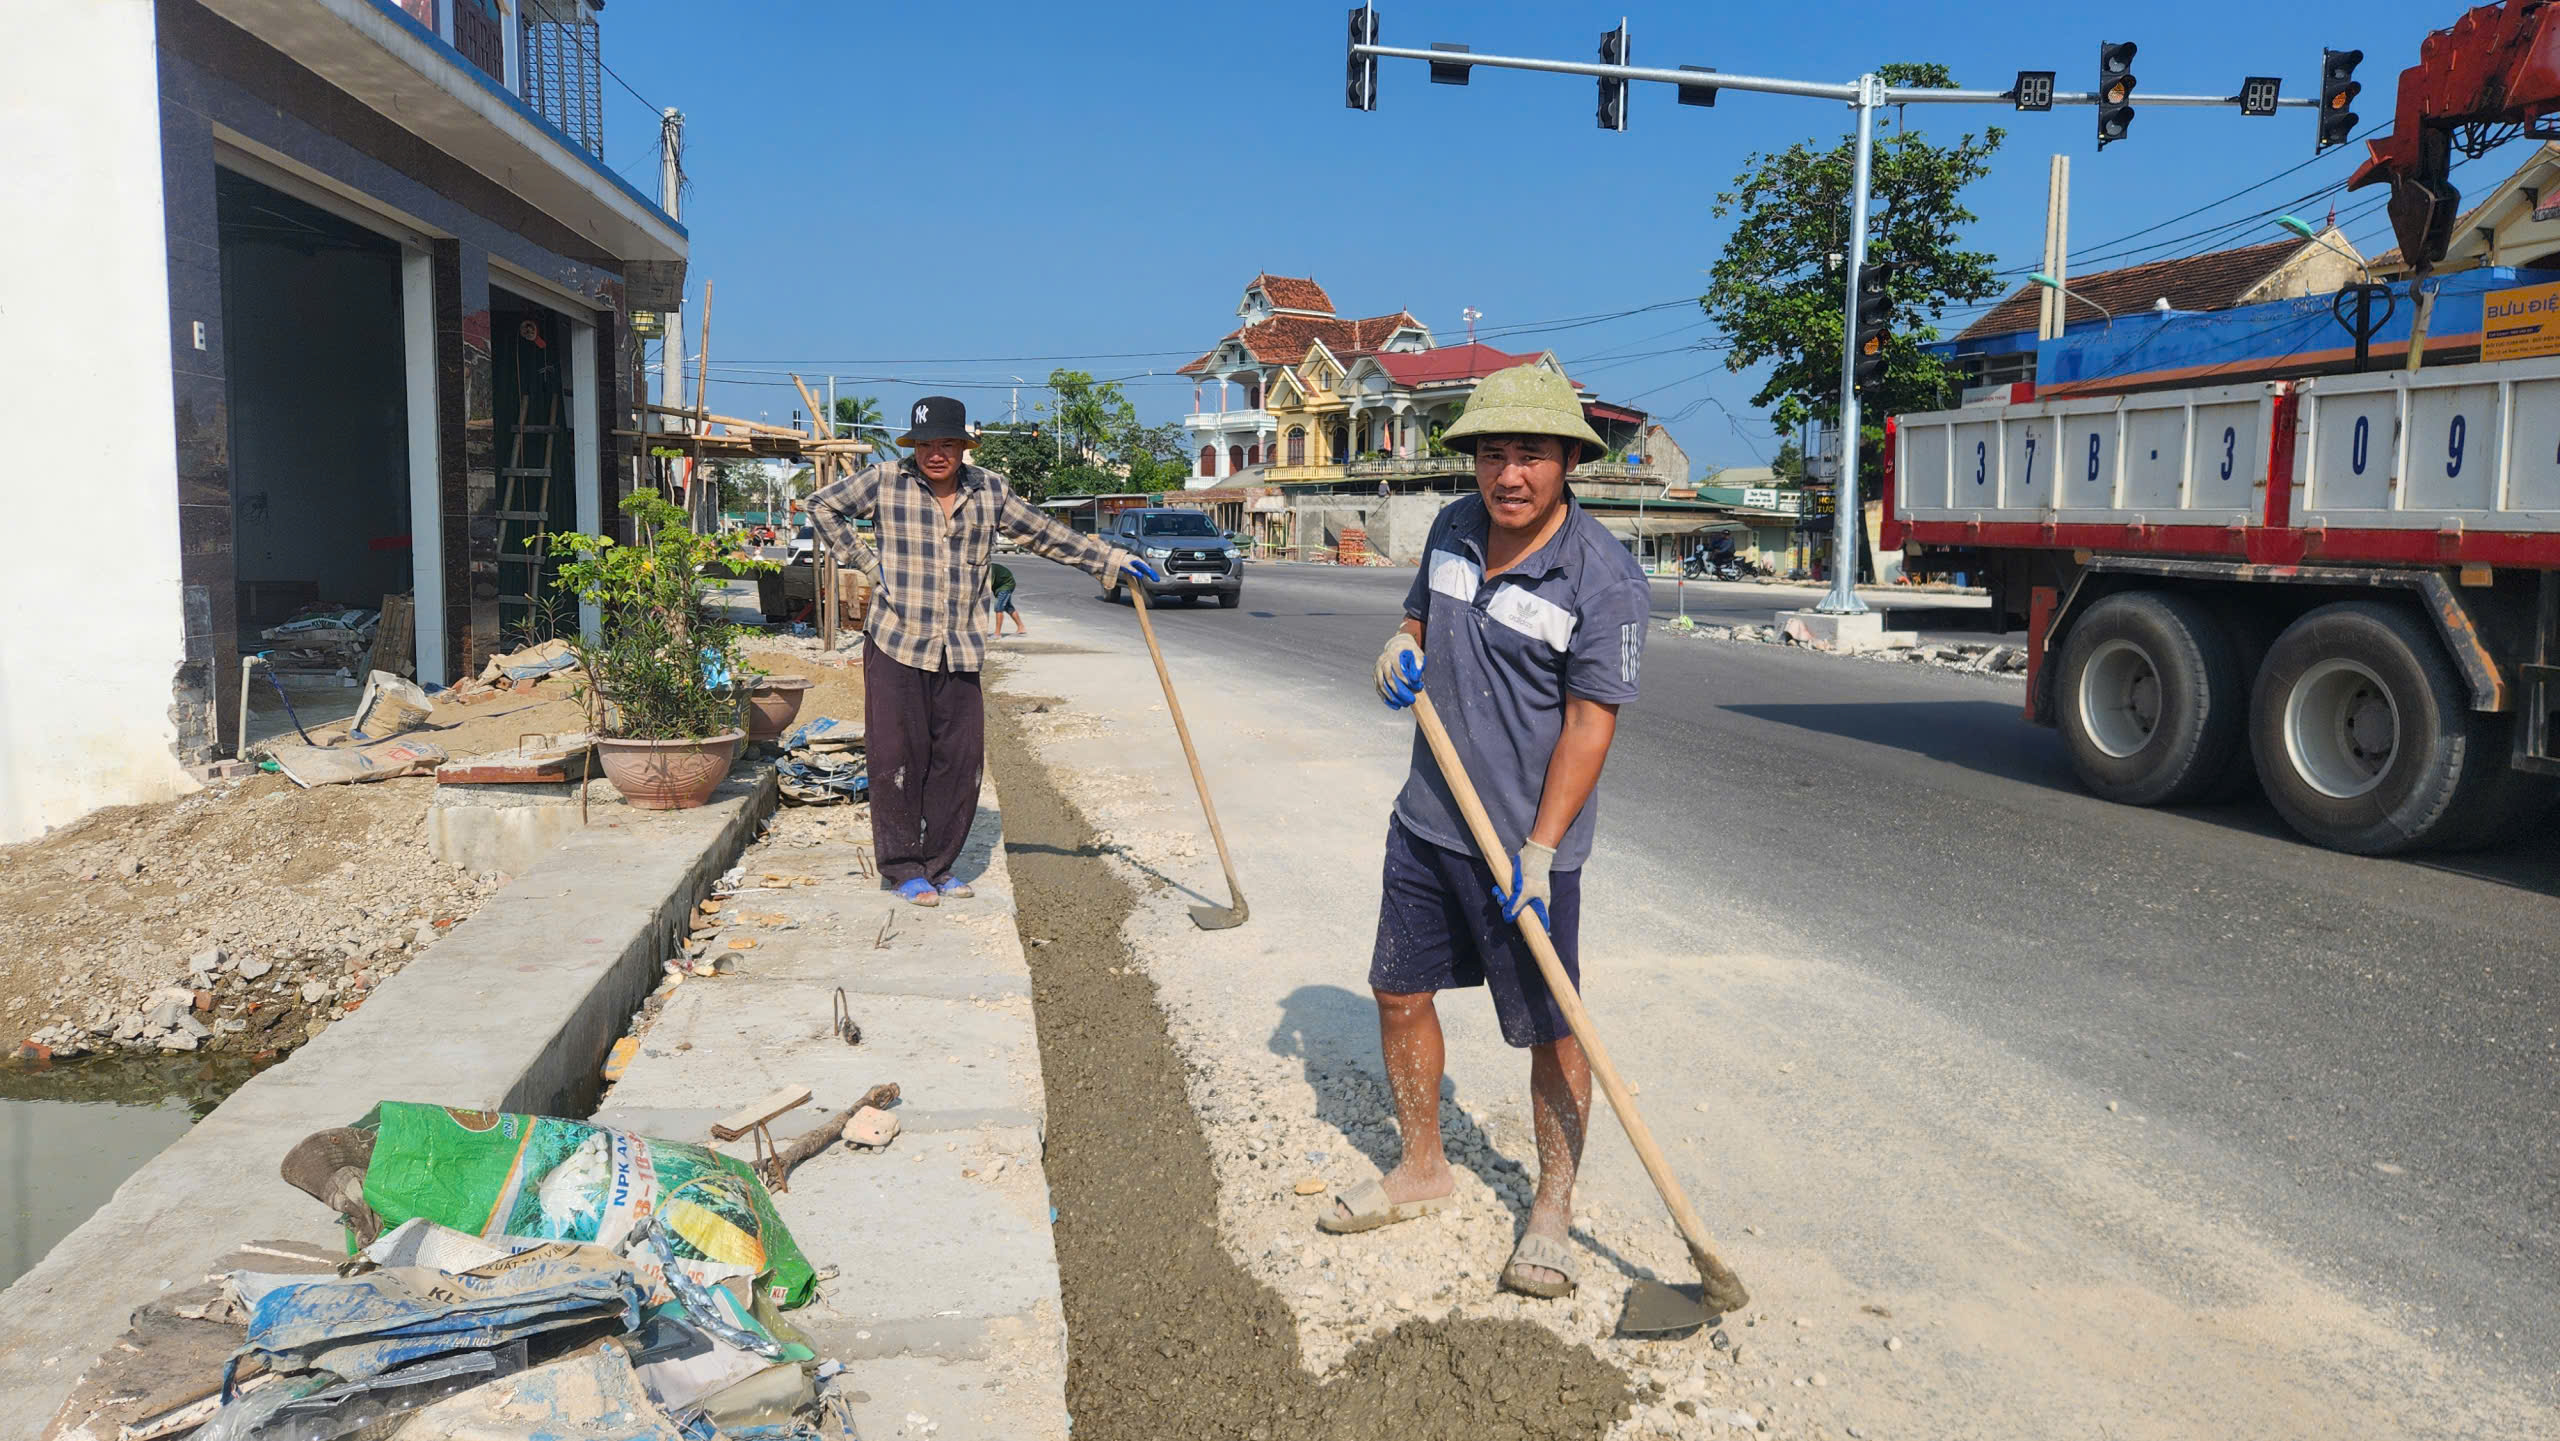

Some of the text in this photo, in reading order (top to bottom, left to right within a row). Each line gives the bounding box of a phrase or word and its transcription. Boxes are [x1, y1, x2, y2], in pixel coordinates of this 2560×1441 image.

[2488, 301, 2525, 318] BƯU
[613, 1162, 630, 1207] NPK
[772, 1288, 787, 1298] KLT
